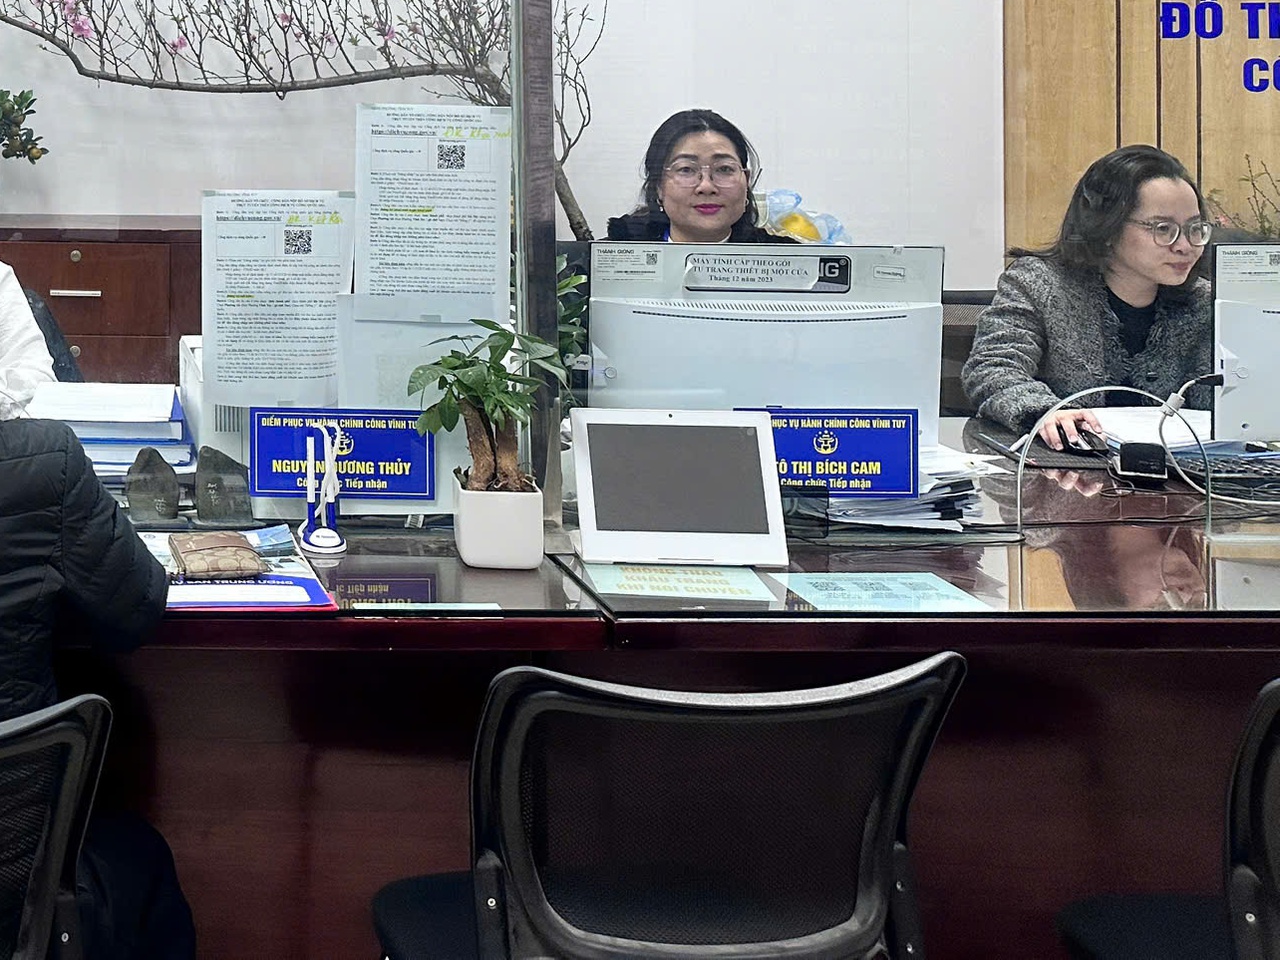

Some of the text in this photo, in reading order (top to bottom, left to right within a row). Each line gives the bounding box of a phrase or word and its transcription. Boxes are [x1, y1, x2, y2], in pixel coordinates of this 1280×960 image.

[1242, 55, 1280, 92] C
[706, 266, 733, 274] TRANG
[282, 417, 304, 429] PHỤC
[340, 417, 364, 428] CHÍNH
[365, 417, 387, 429] CÔNG
[407, 419, 420, 430] TU
[772, 416, 906, 430] HỤC VỤ HÀNH CHÍNH CÔNG VĨNH TUY
[272, 459, 325, 474] NGUYN
[377, 457, 412, 476] THỦY
[791, 460, 812, 477] THỊ
[815, 458, 847, 475] BÍCH
[851, 461, 881, 475] CAM
[296, 477, 387, 490] Côg Tiếp nhận
[829, 477, 848, 489] Tiếp
[849, 477, 872, 489] nhận
